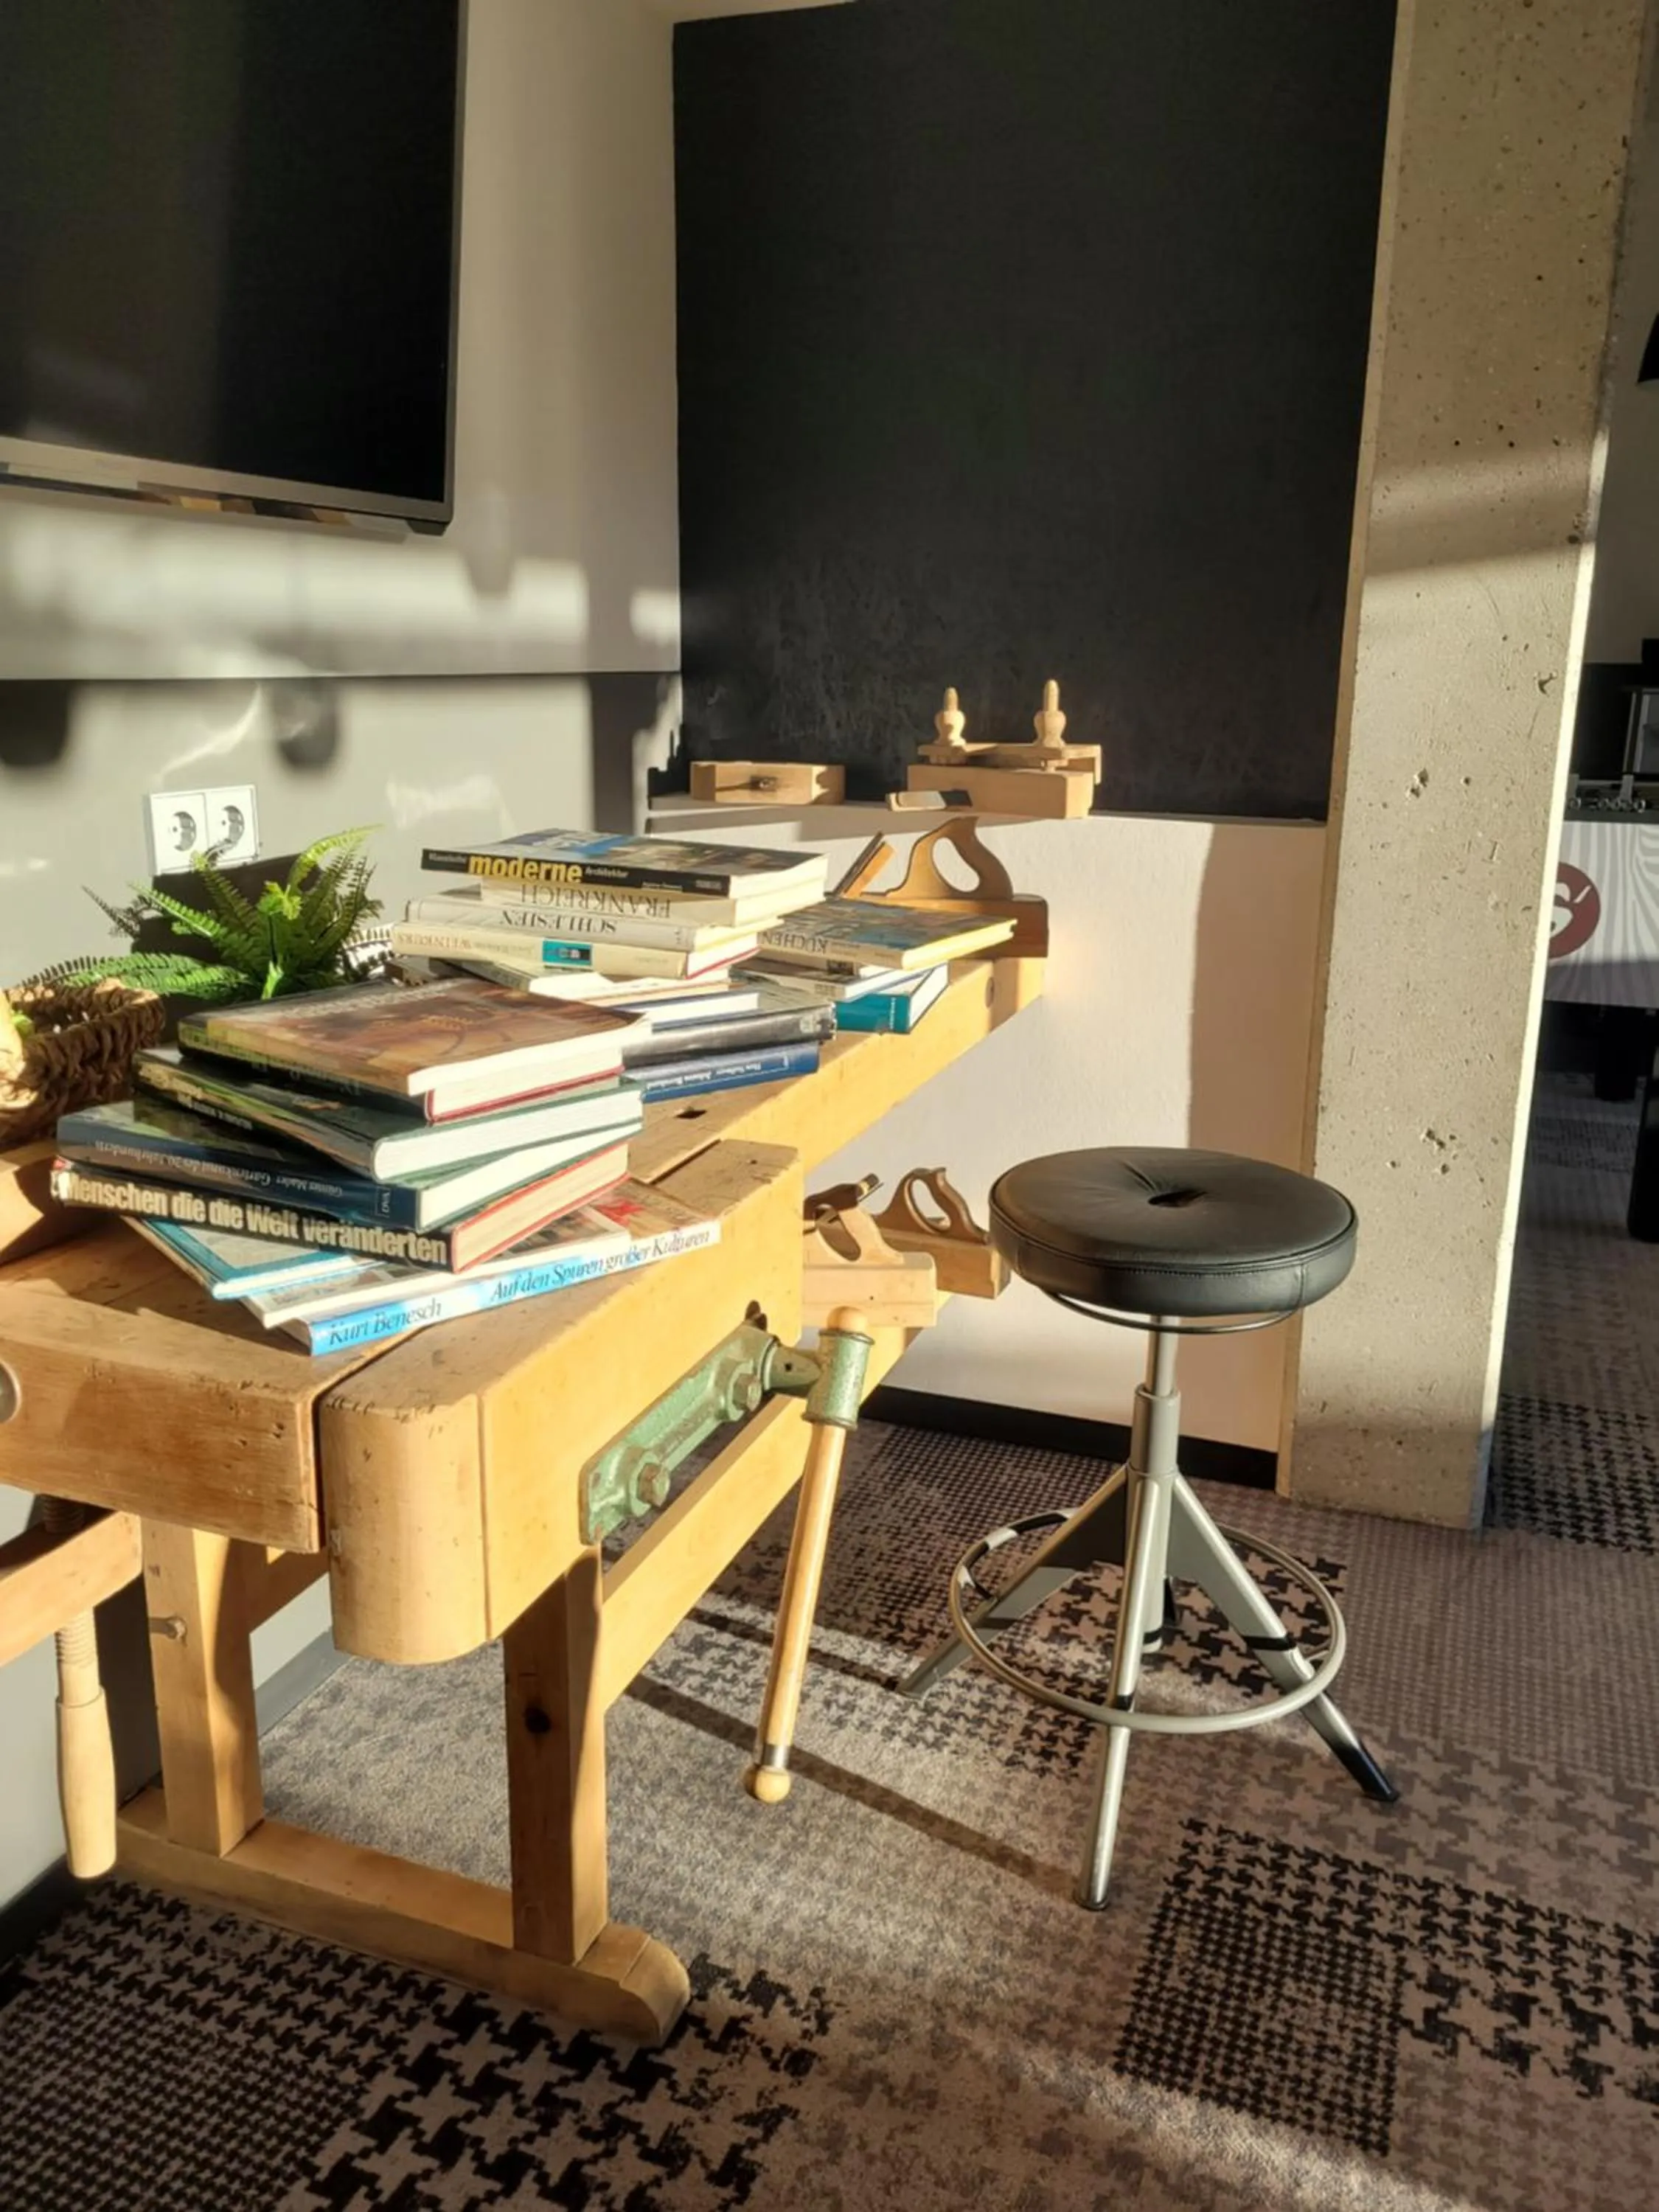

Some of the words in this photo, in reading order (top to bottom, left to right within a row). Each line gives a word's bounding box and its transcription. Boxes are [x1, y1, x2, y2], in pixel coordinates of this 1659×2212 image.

[470, 854, 582, 883] moderne
[521, 883, 670, 919] FRANKREICH
[501, 910, 616, 933] SCHLESIEN
[171, 1192, 206, 1222] die
[209, 1197, 243, 1229] die
[245, 1203, 299, 1239] Welt
[302, 1218, 447, 1265] veränderten
[330, 1321, 369, 1346] Kurt
[373, 1297, 442, 1334] Benesch
[490, 1273, 522, 1301] Auf
[519, 1270, 550, 1293] den
[552, 1262, 605, 1286] Spuren
